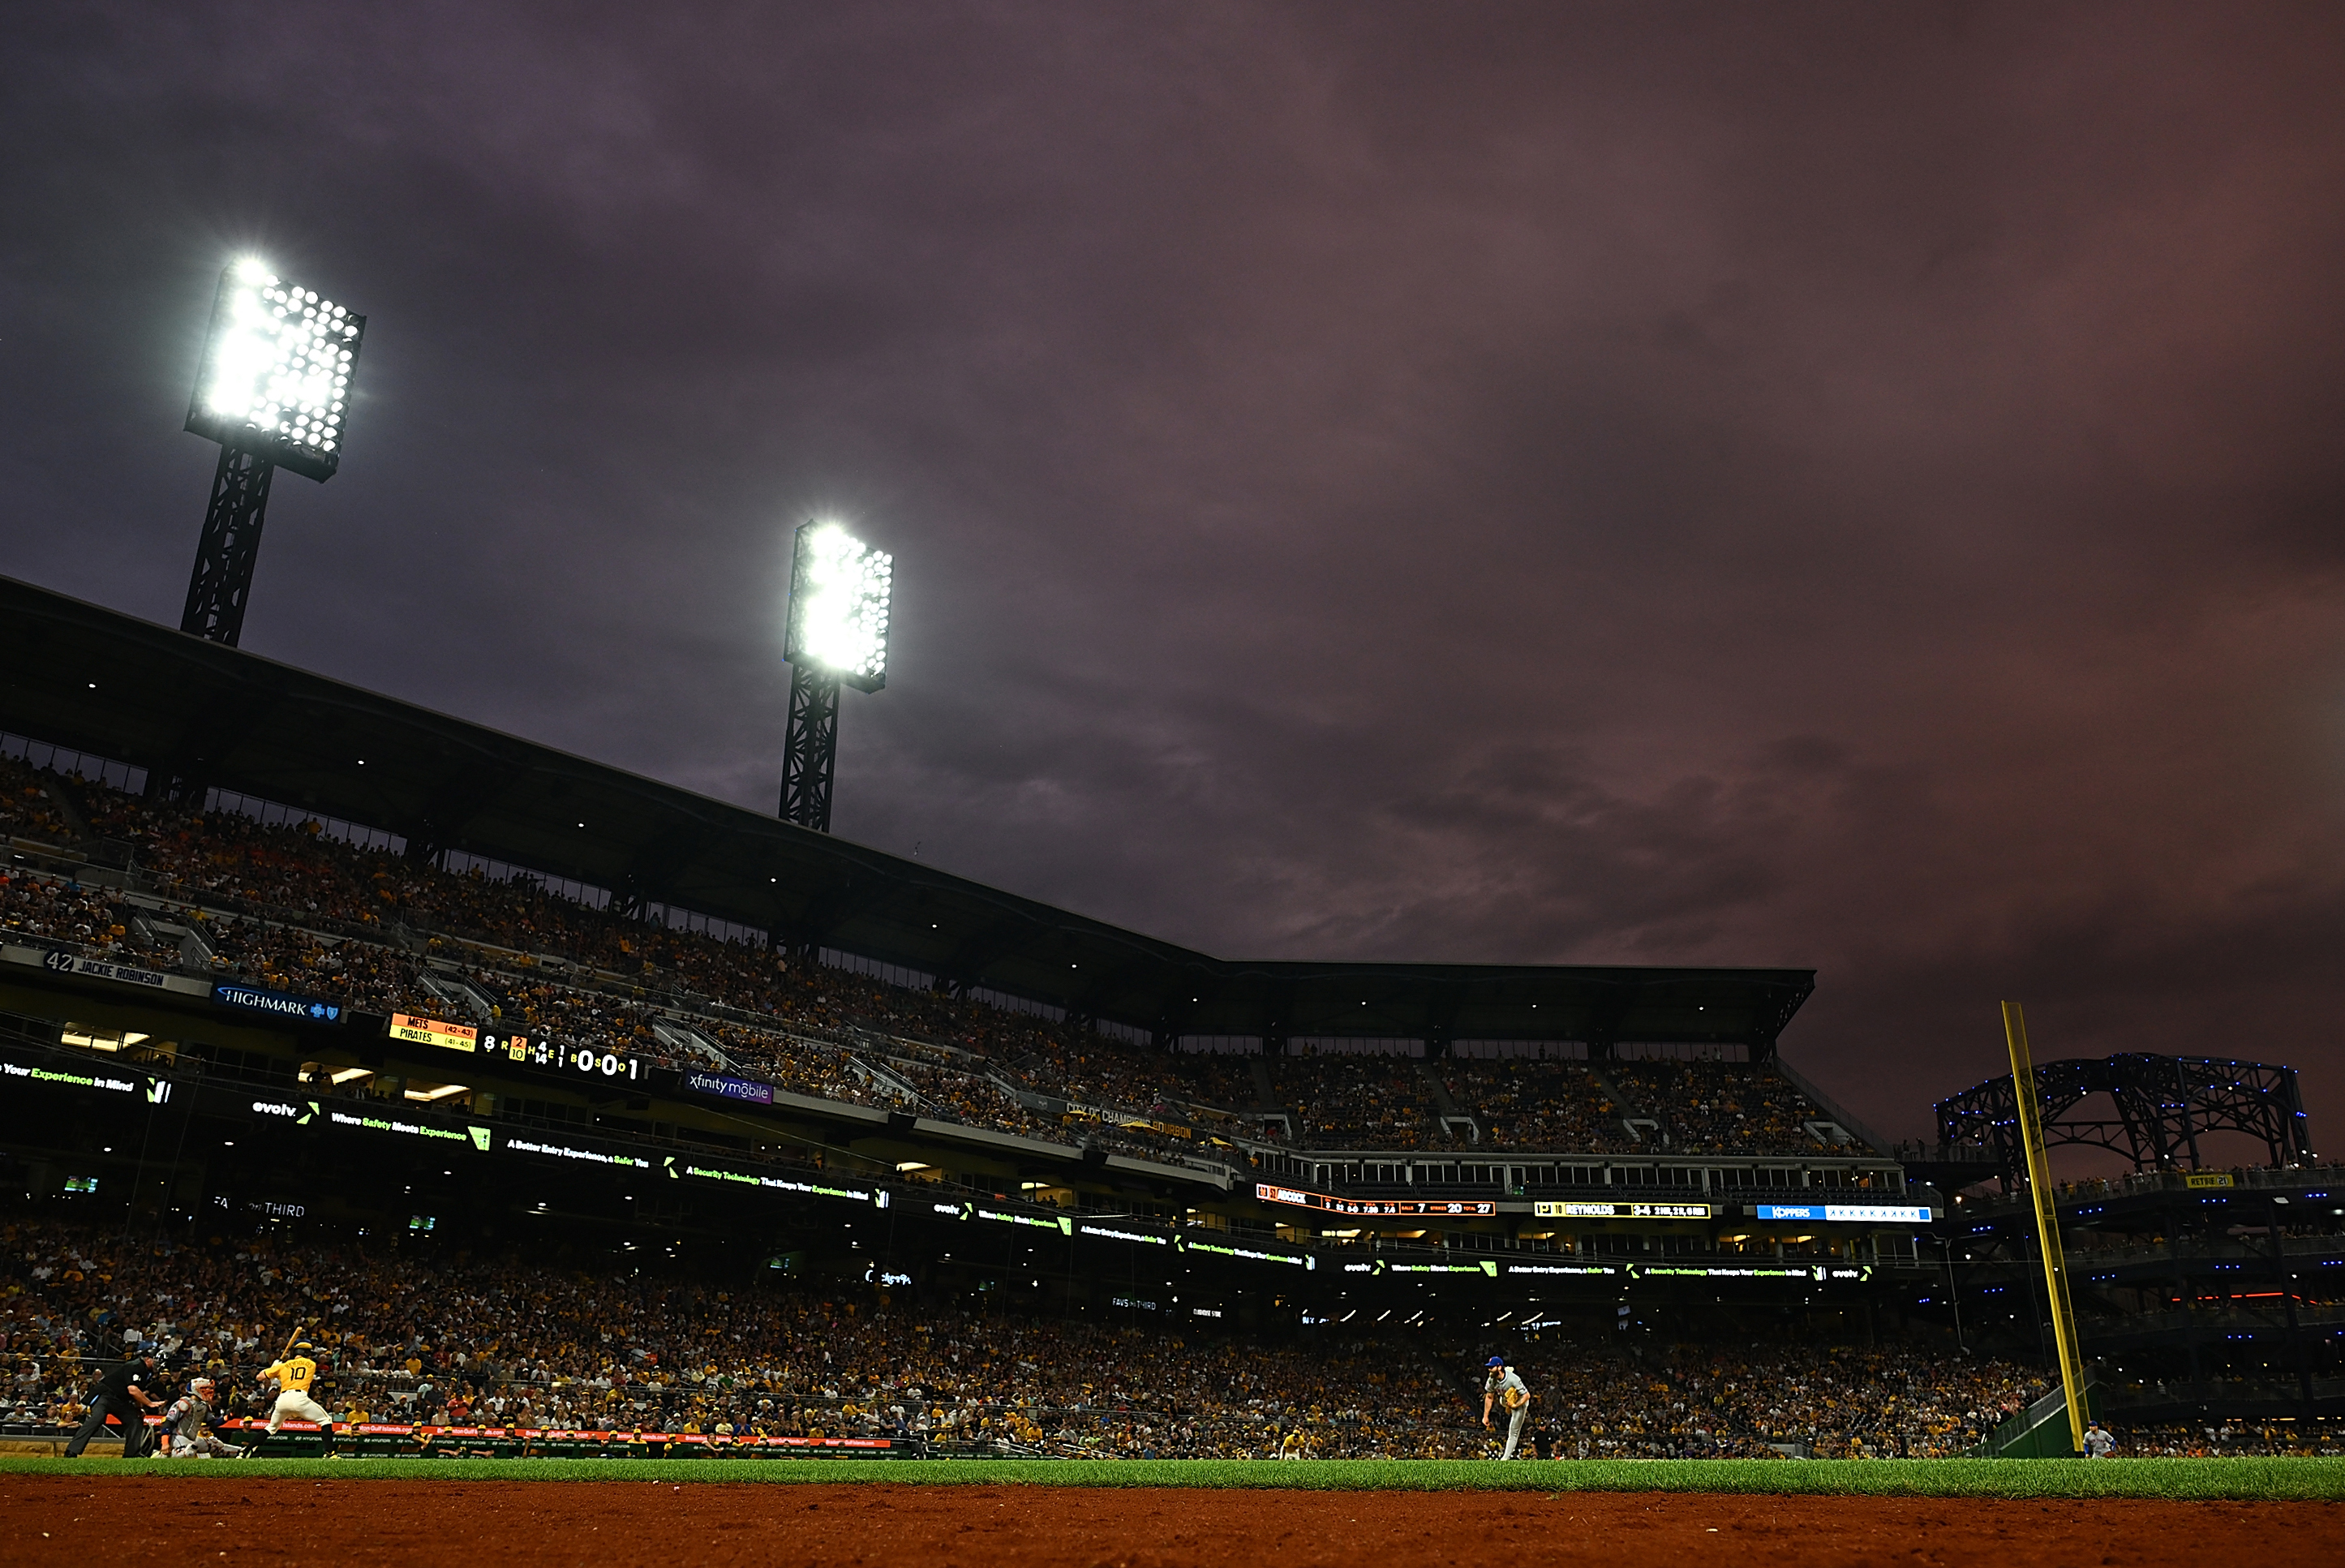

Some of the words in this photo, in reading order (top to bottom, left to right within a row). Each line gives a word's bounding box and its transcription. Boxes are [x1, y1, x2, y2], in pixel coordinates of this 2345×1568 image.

[46, 952, 73, 972] 42
[78, 960, 113, 977] JACKIE
[115, 967, 165, 986] ROBINSON
[225, 990, 307, 1016] HIGHMARK
[407, 1016, 429, 1029] METS
[445, 1025, 474, 1037] (42-43)
[400, 1028, 432, 1043] PIRATES
[445, 1037, 471, 1050] (41-45)
[484, 1035, 496, 1050] 8
[501, 1041, 509, 1050] R
[516, 1038, 523, 1047] 2
[527, 1046, 535, 1055] H
[538, 1042, 547, 1052] 4
[560, 1045, 565, 1055] 1
[512, 1049, 523, 1059] 10
[535, 1051, 548, 1064] 14
[548, 1050, 555, 1059] E
[558, 1056, 564, 1068] 1
[570, 1054, 578, 1063] B
[578, 1050, 594, 1072] 0
[595, 1058, 601, 1068] S
[602, 1054, 617, 1076] 0
[629, 1059, 638, 1080] 1
[4, 1063, 31, 1076] Your
[31, 1068, 93, 1085] Experience
[105, 1079, 134, 1092] Mind
[689, 1074, 728, 1093] xfinity
[332, 1112, 362, 1125] Where
[363, 1117, 391, 1130] Safety
[391, 1122, 419, 1134] Meets
[419, 1126, 467, 1141] Experience
[1152, 1120, 1192, 1140] BOURBON
[507, 1139, 515, 1148] A
[515, 1140, 541, 1152] Better
[541, 1144, 563, 1156] Entry
[614, 1155, 633, 1166] Safer
[634, 1158, 649, 1168] You
[686, 1166, 694, 1175] A
[694, 1167, 722, 1179] Security
[723, 1171, 760, 1185] Technology
[760, 1176, 776, 1187] That
[776, 1179, 797, 1190] Keeps
[797, 1183, 812, 1192] Your
[812, 1185, 846, 1196] Experience
[853, 1191, 869, 1201] Mind
[2218, 1177, 2227, 1185] 21
[1277, 1188, 1306, 1205] ADCOCK
[264, 1201, 305, 1218] THIRD
[1418, 1203, 1425, 1213] 7
[1447, 1203, 1462, 1214] 20
[1477, 1203, 1491, 1214] 27
[1555, 1205, 1562, 1214] 10
[1565, 1204, 1615, 1215] REYNOLDS
[1633, 1205, 1651, 1216] 3-4
[1772, 1206, 1810, 1218] KOPPERS
[997, 1213, 1014, 1223] Safety
[1030, 1218, 1058, 1228] Experience
[1411, 1265, 1430, 1273] Safety
[1449, 1265, 1481, 1273] Experience
[1532, 1265, 1549, 1274] Entry
[1651, 1268, 1675, 1277] Security
[1675, 1267, 1707, 1276] Technology
[1707, 1268, 1721, 1276] That
[1721, 1268, 1740, 1277] Keeps
[1754, 1269, 1785, 1277] Experience
[1112, 1297, 1129, 1308] FAVS
[1136, 1300, 1157, 1311] THIRD
[284, 1360, 314, 1369] REYNOLDS
[290, 1367, 306, 1381] 10
